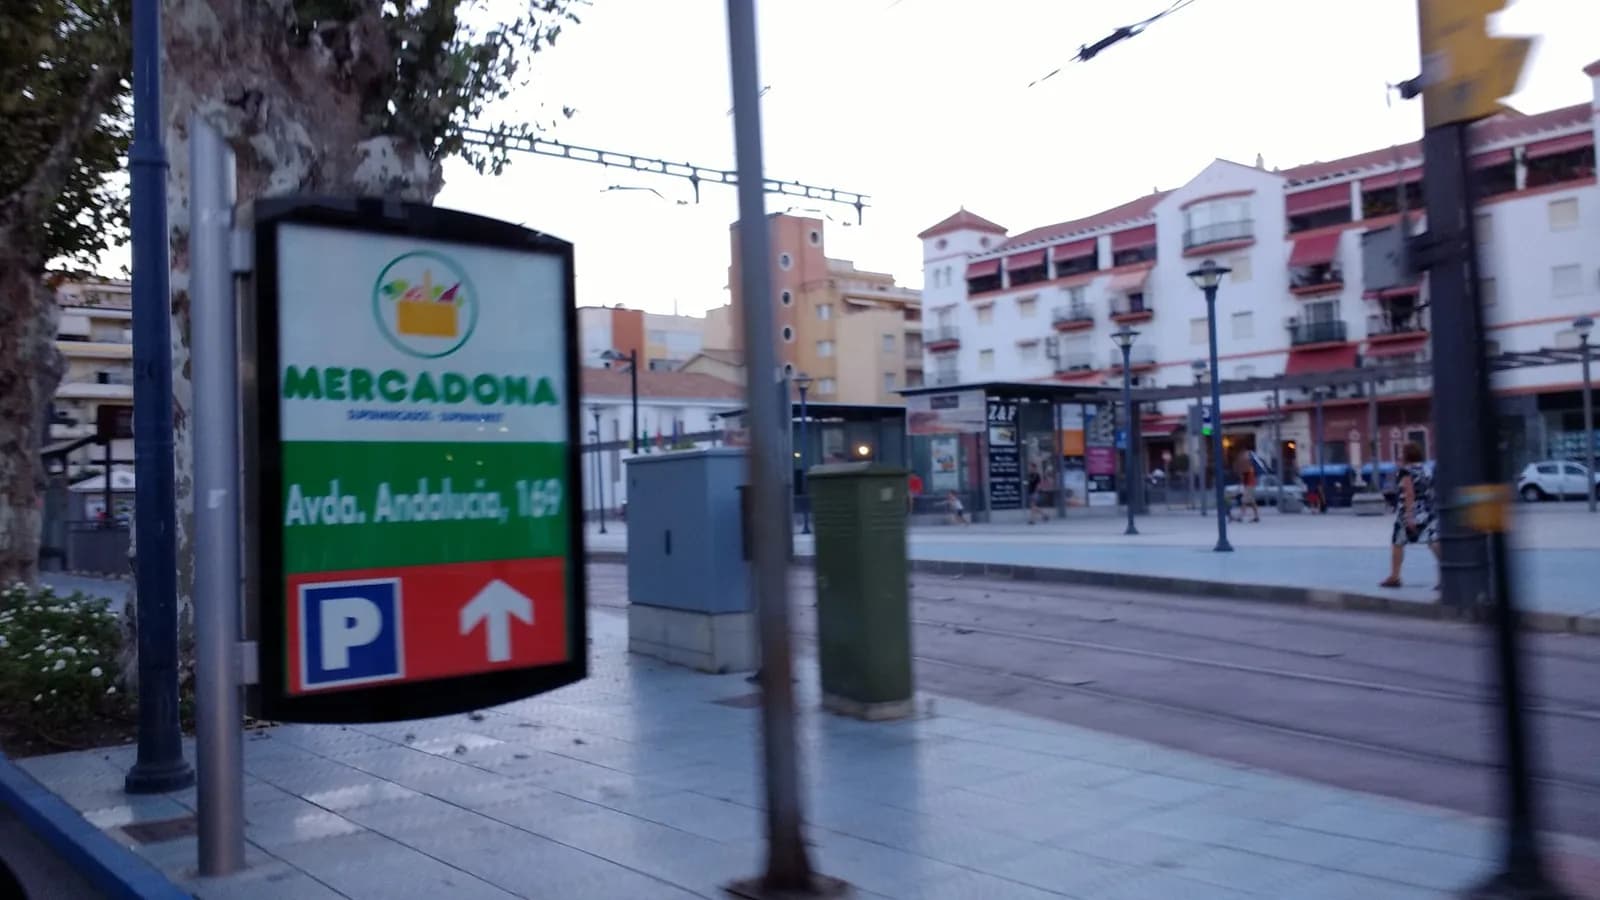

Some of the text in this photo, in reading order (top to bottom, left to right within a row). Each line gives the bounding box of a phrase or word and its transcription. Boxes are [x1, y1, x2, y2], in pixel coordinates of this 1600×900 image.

[283, 365, 559, 405] MERCADONA
[285, 479, 366, 526] Avda.
[515, 478, 562, 518] 169
[319, 597, 383, 671] P
